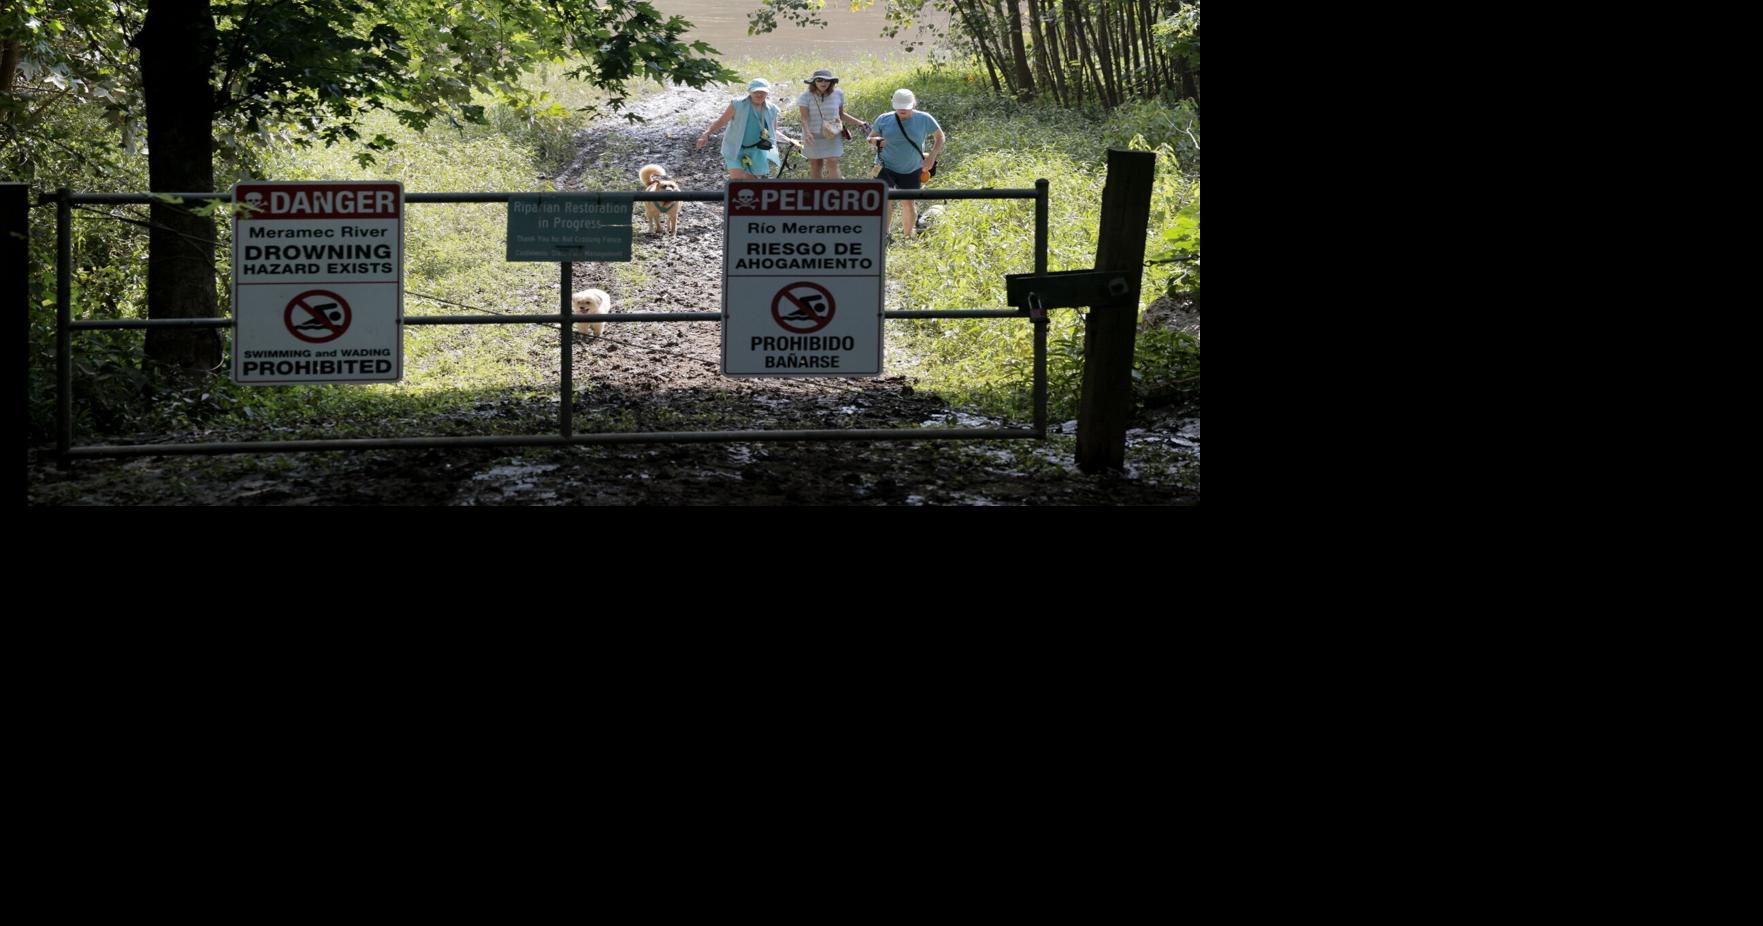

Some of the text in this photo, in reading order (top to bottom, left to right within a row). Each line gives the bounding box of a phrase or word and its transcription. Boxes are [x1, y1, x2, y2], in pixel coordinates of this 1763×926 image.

[271, 191, 395, 214] DANGER
[761, 189, 880, 211] PELIGRO
[565, 201, 628, 214] Restoration
[538, 217, 602, 231] in Progress
[748, 222, 862, 234] Río Meramec
[250, 226, 388, 238] Meramec River
[245, 245, 391, 260] DROWNING
[747, 243, 862, 256] RIESGO DE
[243, 263, 392, 275] HAZARD EXISTS
[735, 258, 872, 270] AHOGAMIENTO
[751, 336, 855, 351] PROHIBIDO
[244, 349, 390, 359] SWIMMING and WADING
[765, 353, 840, 368] BAÑARSE
[243, 360, 392, 376] PROHIBITED
